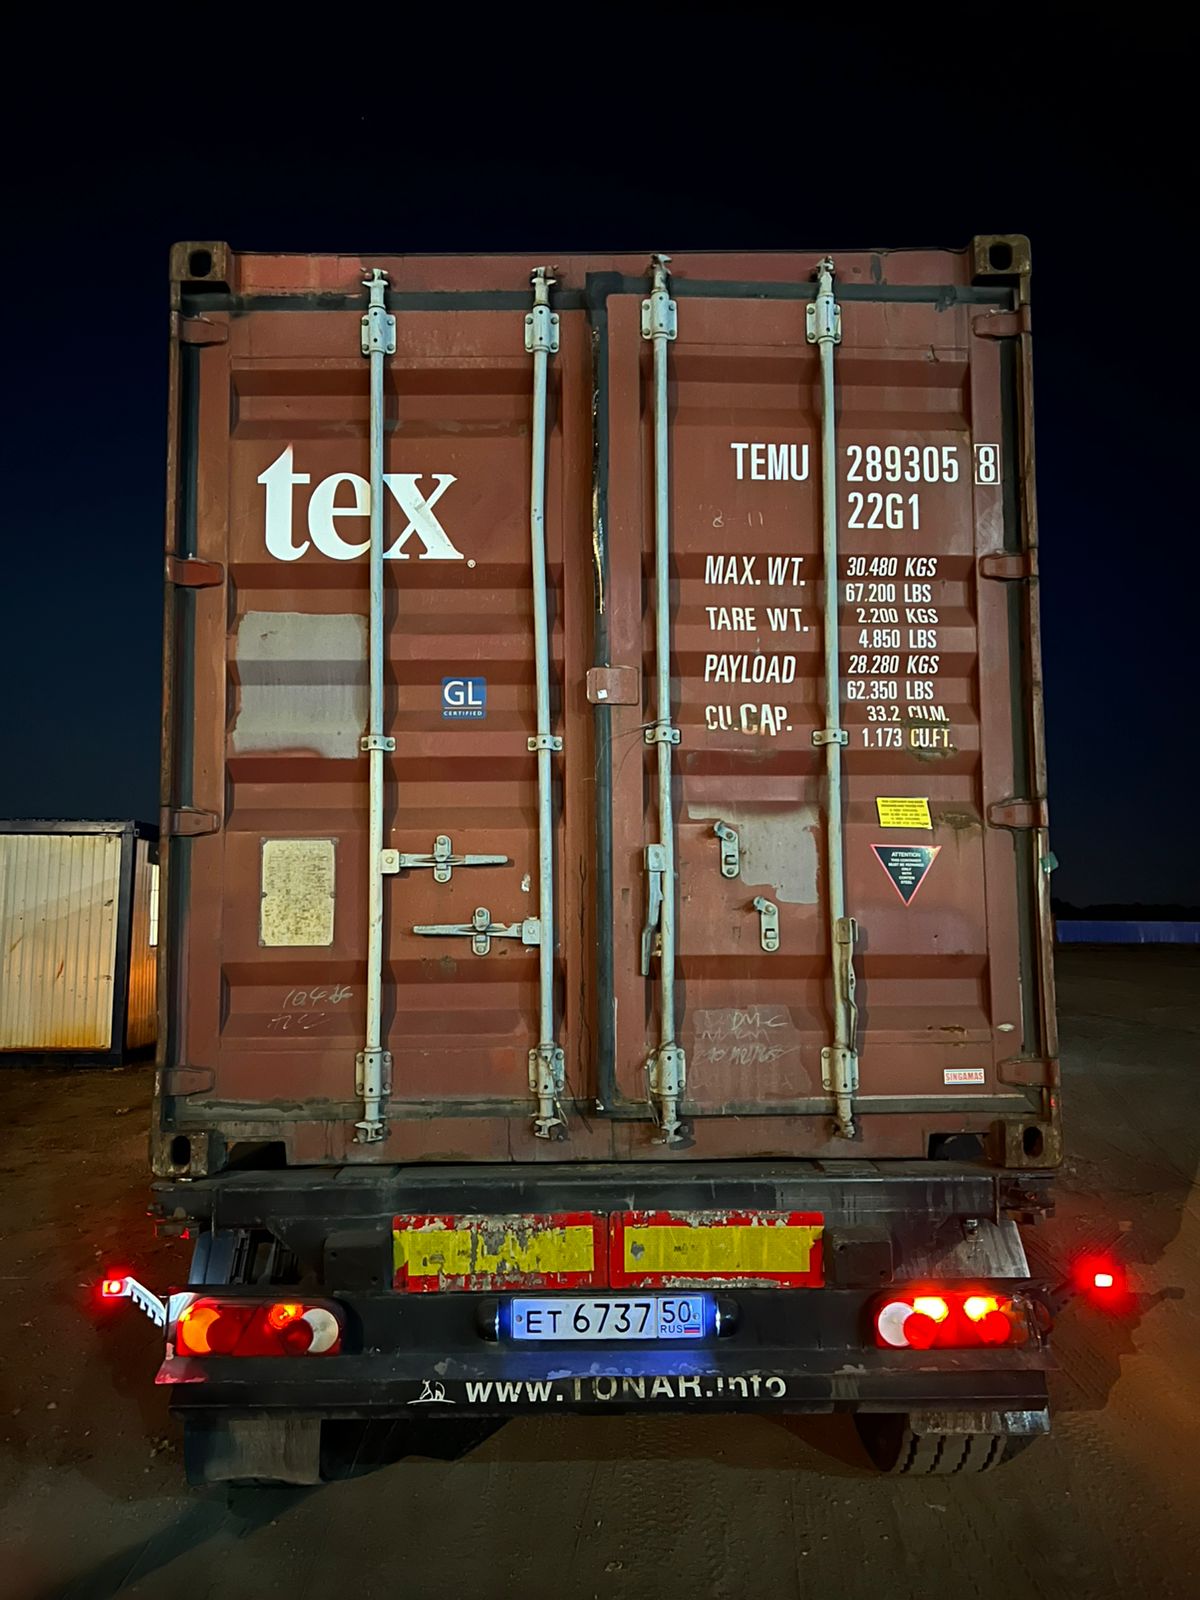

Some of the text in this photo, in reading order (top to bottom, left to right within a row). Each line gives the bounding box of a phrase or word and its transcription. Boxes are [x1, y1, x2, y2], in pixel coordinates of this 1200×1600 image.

[730, 443, 995, 482] TEMU 289305 8
[257, 441, 464, 561] tex
[847, 492, 920, 530] 22G1
[704, 555, 938, 587] MAX. WT. 30.480 KGS
[845, 583, 932, 603] 67.200 LBS
[705, 606, 939, 632] TARE WT. 2.200 KGS
[858, 629, 937, 648] 4.850 LBS
[704, 654, 940, 684] PAYLOAD 28.280 KGS
[444, 680, 483, 705] GL
[847, 680, 934, 700] 62.350 LBS
[866, 705, 902, 722] 33.2
[862, 727, 953, 749] 1.173 CU.FT.
[945, 1072, 983, 1081] SINGAMAS
[572, 1303, 650, 1333] 6737
[661, 1301, 691, 1324] 50
[660, 1324, 683, 1334] RUS
